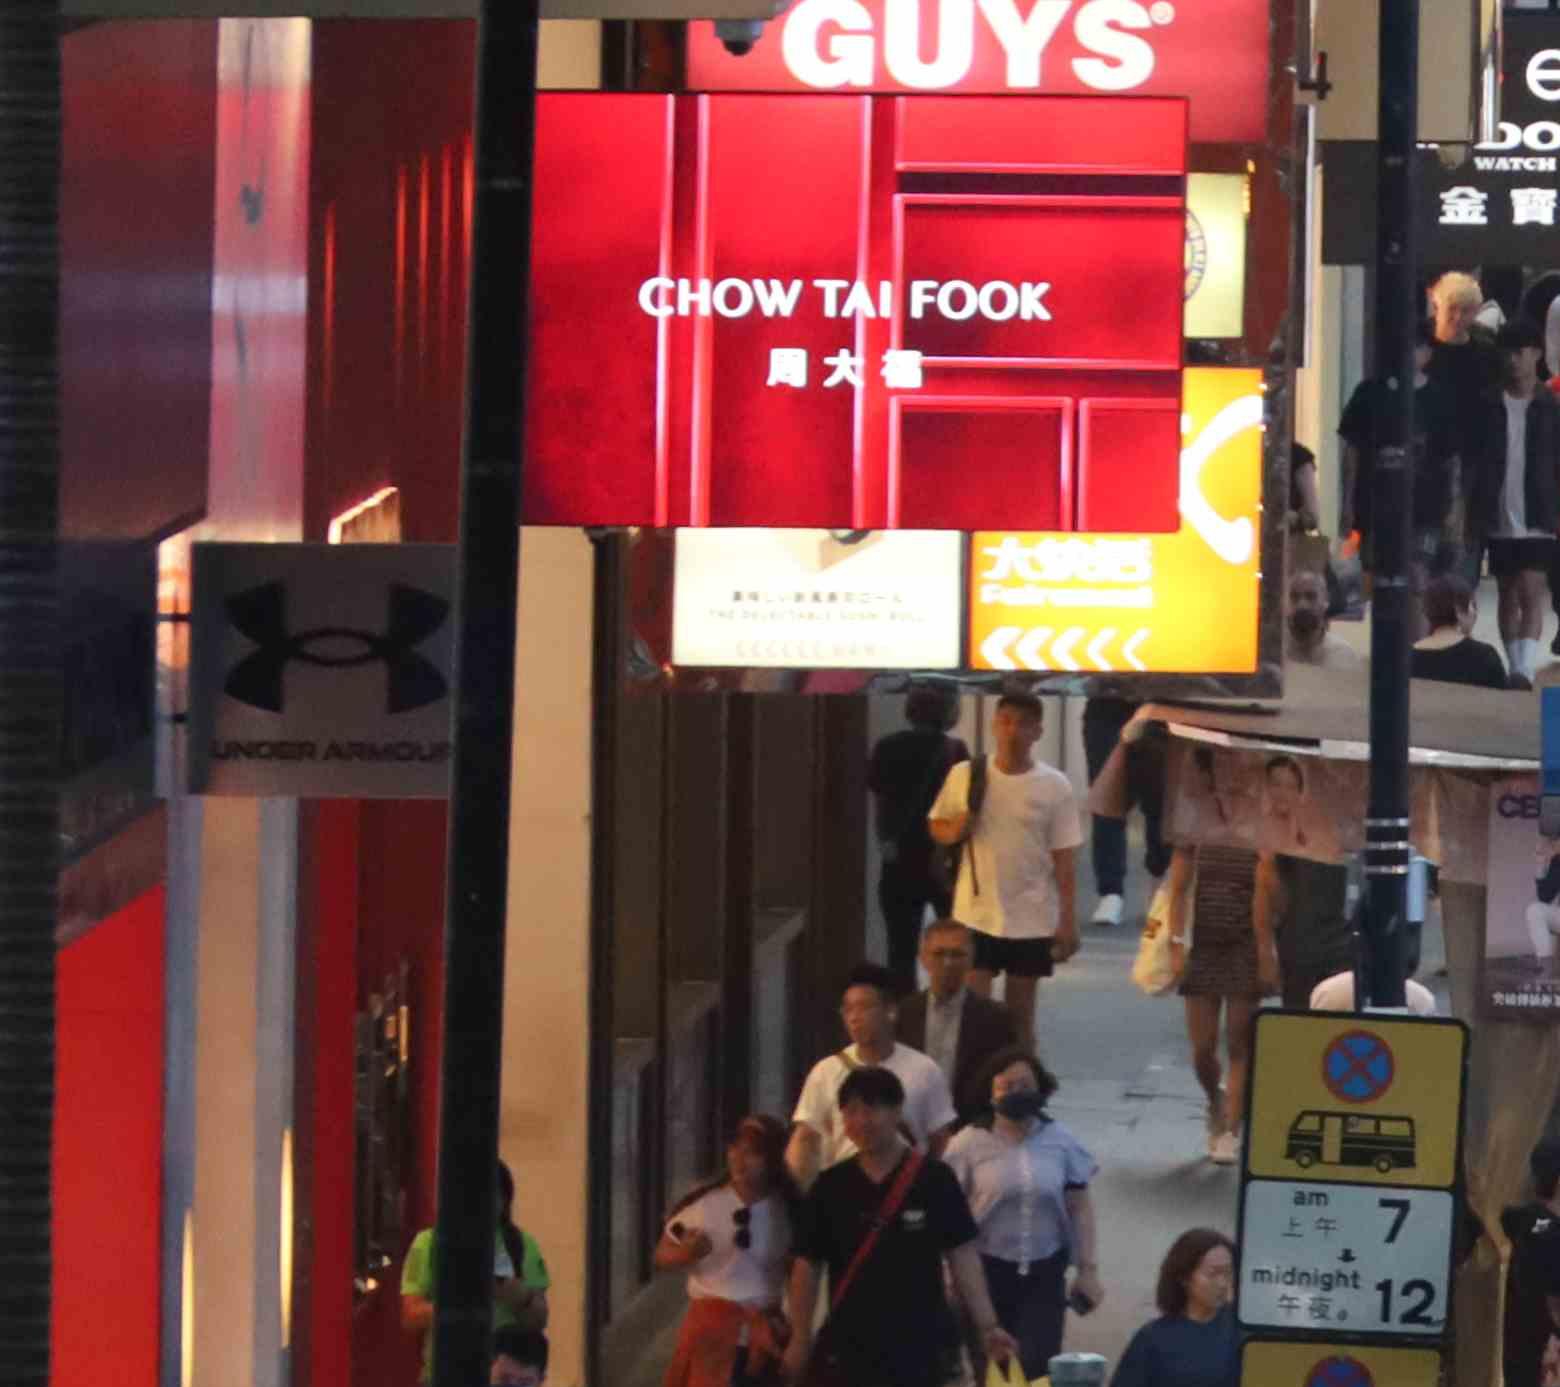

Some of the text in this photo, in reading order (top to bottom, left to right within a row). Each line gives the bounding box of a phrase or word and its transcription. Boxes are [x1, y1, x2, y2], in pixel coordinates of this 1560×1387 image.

[782, 0, 1155, 90] GUYS
[1474, 157, 1556, 172] WATCH
[638, 277, 1052, 320] CHOW TAI FOOK
[766, 347, 924, 389] 周大福
[211, 741, 317, 762] UNDER
[1281, 1216, 1338, 1240] 上午
[1293, 1189, 1410, 1243] am 7
[1251, 1265, 1436, 1324] midnight 12
